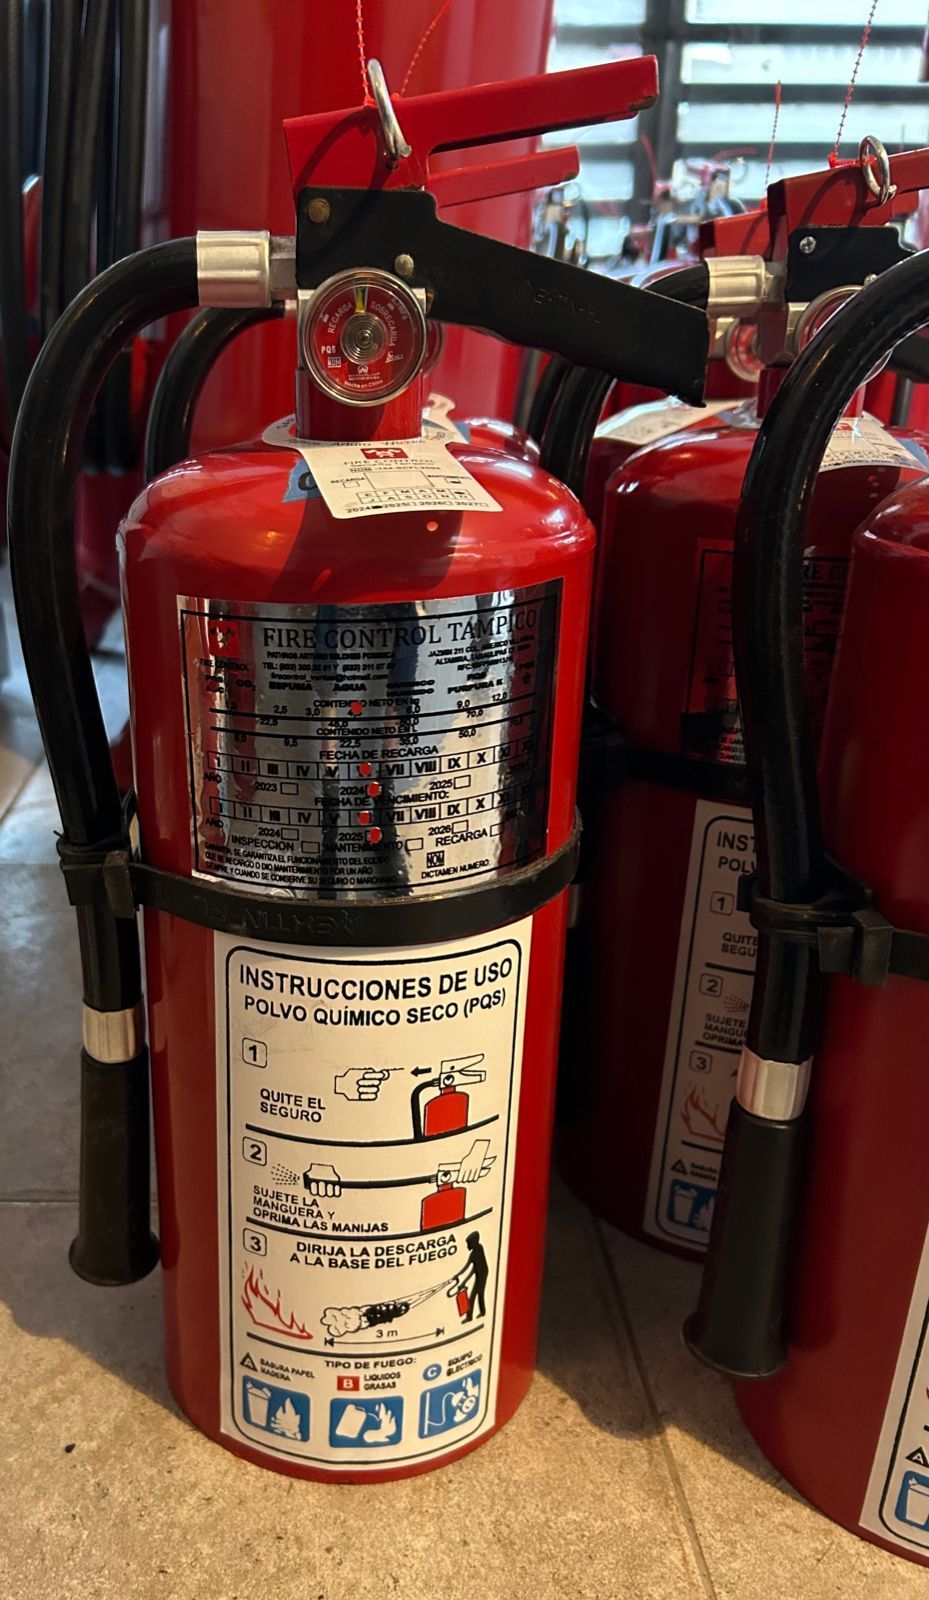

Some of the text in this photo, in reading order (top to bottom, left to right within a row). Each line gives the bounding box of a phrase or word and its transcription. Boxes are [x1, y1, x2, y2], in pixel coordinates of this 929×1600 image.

[328, 302, 354, 334] RECARGA
[331, 476, 366, 484] RECARGA
[346, 506, 371, 514] 2024
[263, 628, 316, 648] FIRE
[325, 624, 442, 648] CONTROL
[262, 661, 278, 670] TEL:
[333, 682, 368, 692] AGUA
[274, 691, 508, 717] 2,5 3,0 9,0 12,0
[367, 698, 394, 708] NETO
[466, 709, 484, 719] 70,0
[316, 727, 369, 737] CONTENIDO
[371, 727, 396, 736] NETO
[458, 727, 477, 739] 50,0
[319, 745, 439, 761] FECHA DE RECARGA
[267, 763, 280, 775] III
[296, 765, 311, 777] IV
[386, 763, 405, 776] VII
[415, 760, 438, 773] VIII
[447, 757, 462, 769] IX
[476, 752, 487, 764] X
[203, 772, 454, 796] AÑO 2023 2024 2025
[243, 806, 253, 818] II
[269, 810, 281, 822] III
[297, 811, 312, 823] IV
[386, 810, 405, 822] VII
[414, 807, 437, 820] VIII
[447, 803, 461, 816] IX
[475, 797, 486, 810] X
[314, 796, 353, 808] FECHA
[354, 796, 370, 807] DE
[205, 817, 452, 842] AÑO 2024 2025 2026
[231, 835, 295, 851] INSPECCION
[435, 829, 488, 847] RECARGA
[226, 855, 254, 869] RECARGO
[346, 867, 357, 875] UN
[357, 864, 373, 875] AÑO
[242, 849, 278, 862] GARANTIZA
[278, 855, 286, 863] EL
[349, 857, 363, 866] DEL
[427, 852, 444, 868] NOM
[234, 867, 260, 880] CUANDO
[261, 872, 270, 881] SE
[270, 873, 307, 884] CONSERVE
[308, 875, 318, 884] SU
[421, 866, 459, 880] DICTAMEN
[717, 896, 725, 911] 1
[722, 931, 759, 946] QUITE
[721, 943, 757, 957] SEGU
[240, 957, 513, 1001] INSTRUCCIONES DE USO
[706, 978, 719, 993] 2
[244, 988, 506, 1026] POLVO QUÍMICO SECO (PQS)
[705, 1013, 746, 1029] SUJETE
[702, 1031, 744, 1046] OPRIMA
[248, 1044, 259, 1062] 1
[697, 1056, 706, 1071] 3
[260, 1087, 327, 1111] QUITE EL
[260, 1102, 323, 1124] SEGURO
[250, 1144, 263, 1162] 2
[253, 1184, 320, 1209] SUJETE LA
[253, 1195, 336, 1221] MANGUERA Y
[253, 1207, 390, 1234] OPRIMA LAS MANIJAS
[250, 1236, 262, 1253] 3
[296, 1233, 458, 1259] DIRIJA LA DESCARGA
[289, 1244, 458, 1270] A LA BASE DEL FUEGO
[376, 1328, 399, 1339] 3 m
[325, 1356, 417, 1370] TIPO DE FUEGO:
[446, 1354, 483, 1376] ELECTRICO
[447, 1350, 473, 1367] EQUIPO
[260, 1358, 316, 1380] BASURA PAPEL
[260, 1367, 291, 1383] MADERA
[363, 1371, 401, 1382] LIQUIDOS
[427, 1366, 438, 1378] C
[342, 1378, 355, 1390] B
[363, 1381, 397, 1391] GRASAS
